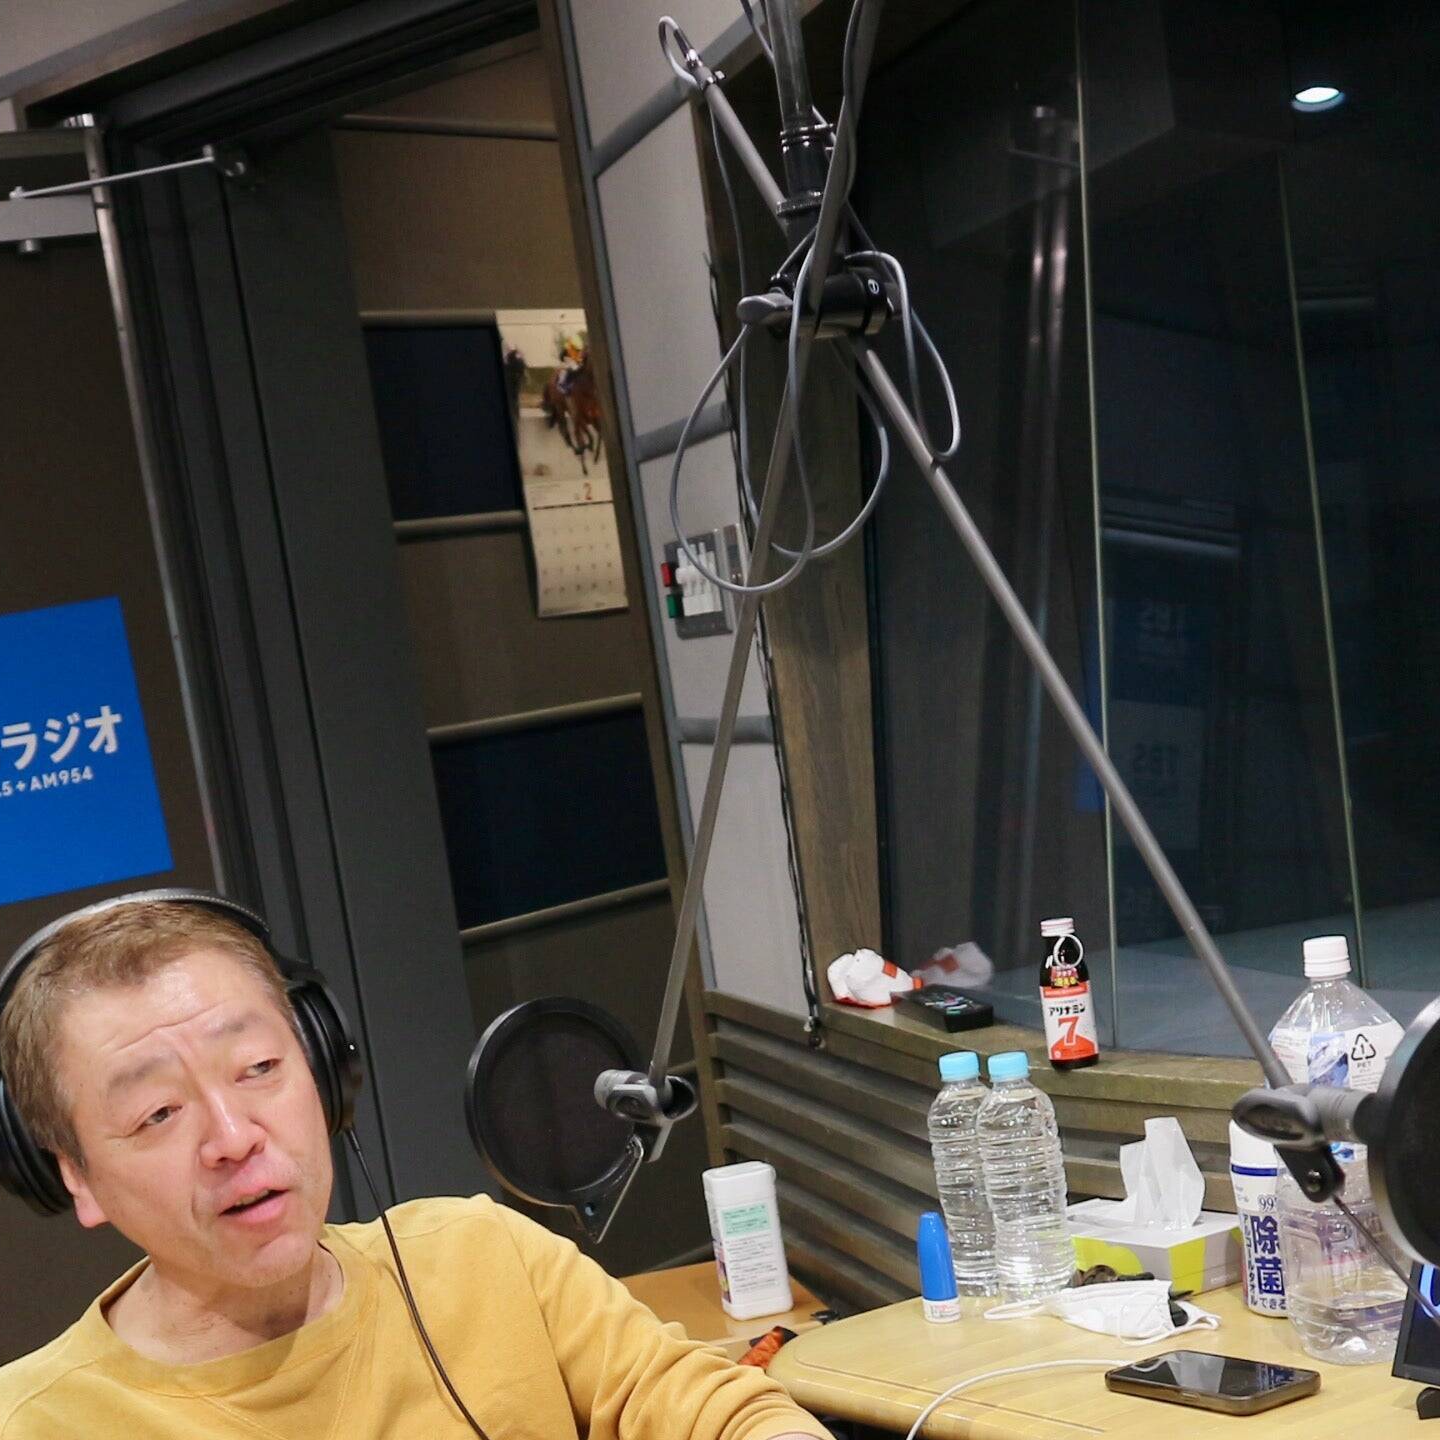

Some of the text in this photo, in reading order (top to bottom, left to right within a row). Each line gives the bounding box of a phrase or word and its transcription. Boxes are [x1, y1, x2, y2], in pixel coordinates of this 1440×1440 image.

[1048, 1004, 1086, 1017] アリナミン
[1057, 1016, 1080, 1046] 7
[1250, 1215, 1286, 1296] 除菌
